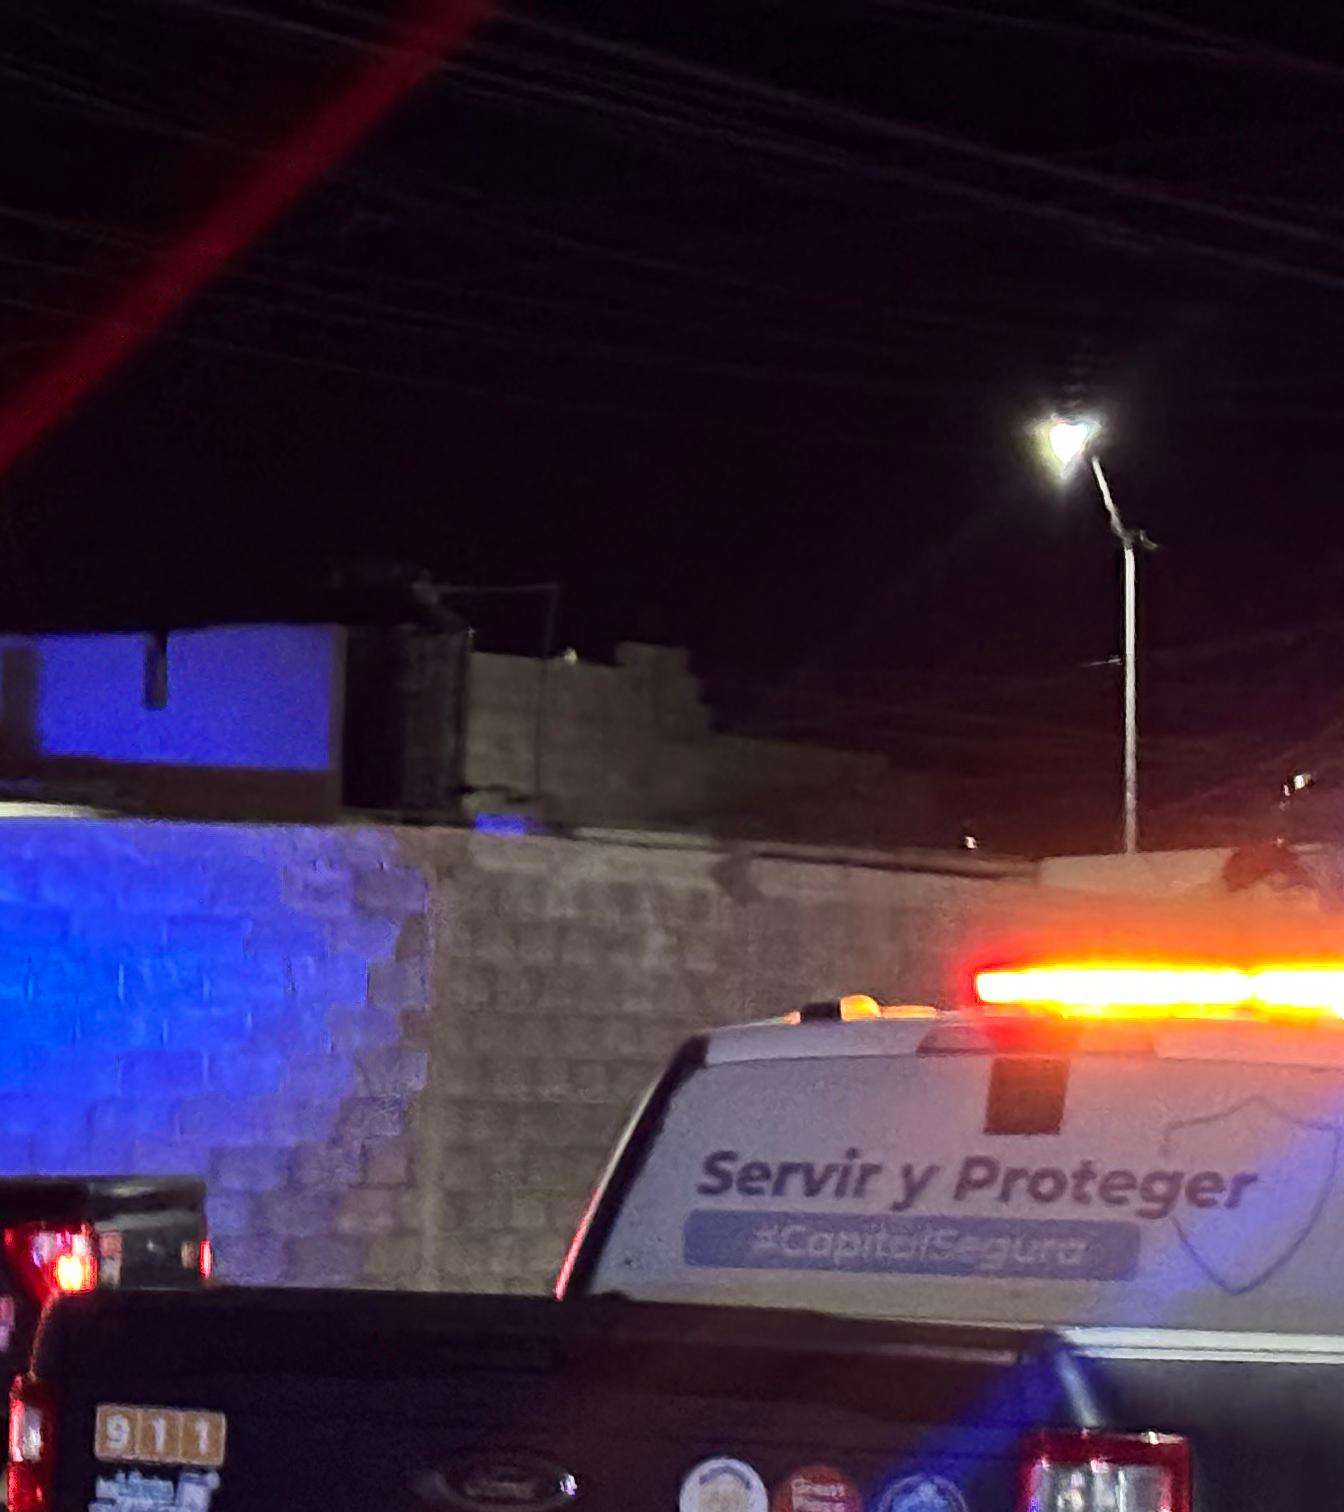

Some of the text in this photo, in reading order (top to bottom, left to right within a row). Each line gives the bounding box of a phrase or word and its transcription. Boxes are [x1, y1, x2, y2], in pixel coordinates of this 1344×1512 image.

[696, 1147, 1258, 1219] Servir y Proteger
[106, 1414, 209, 1457] 911
